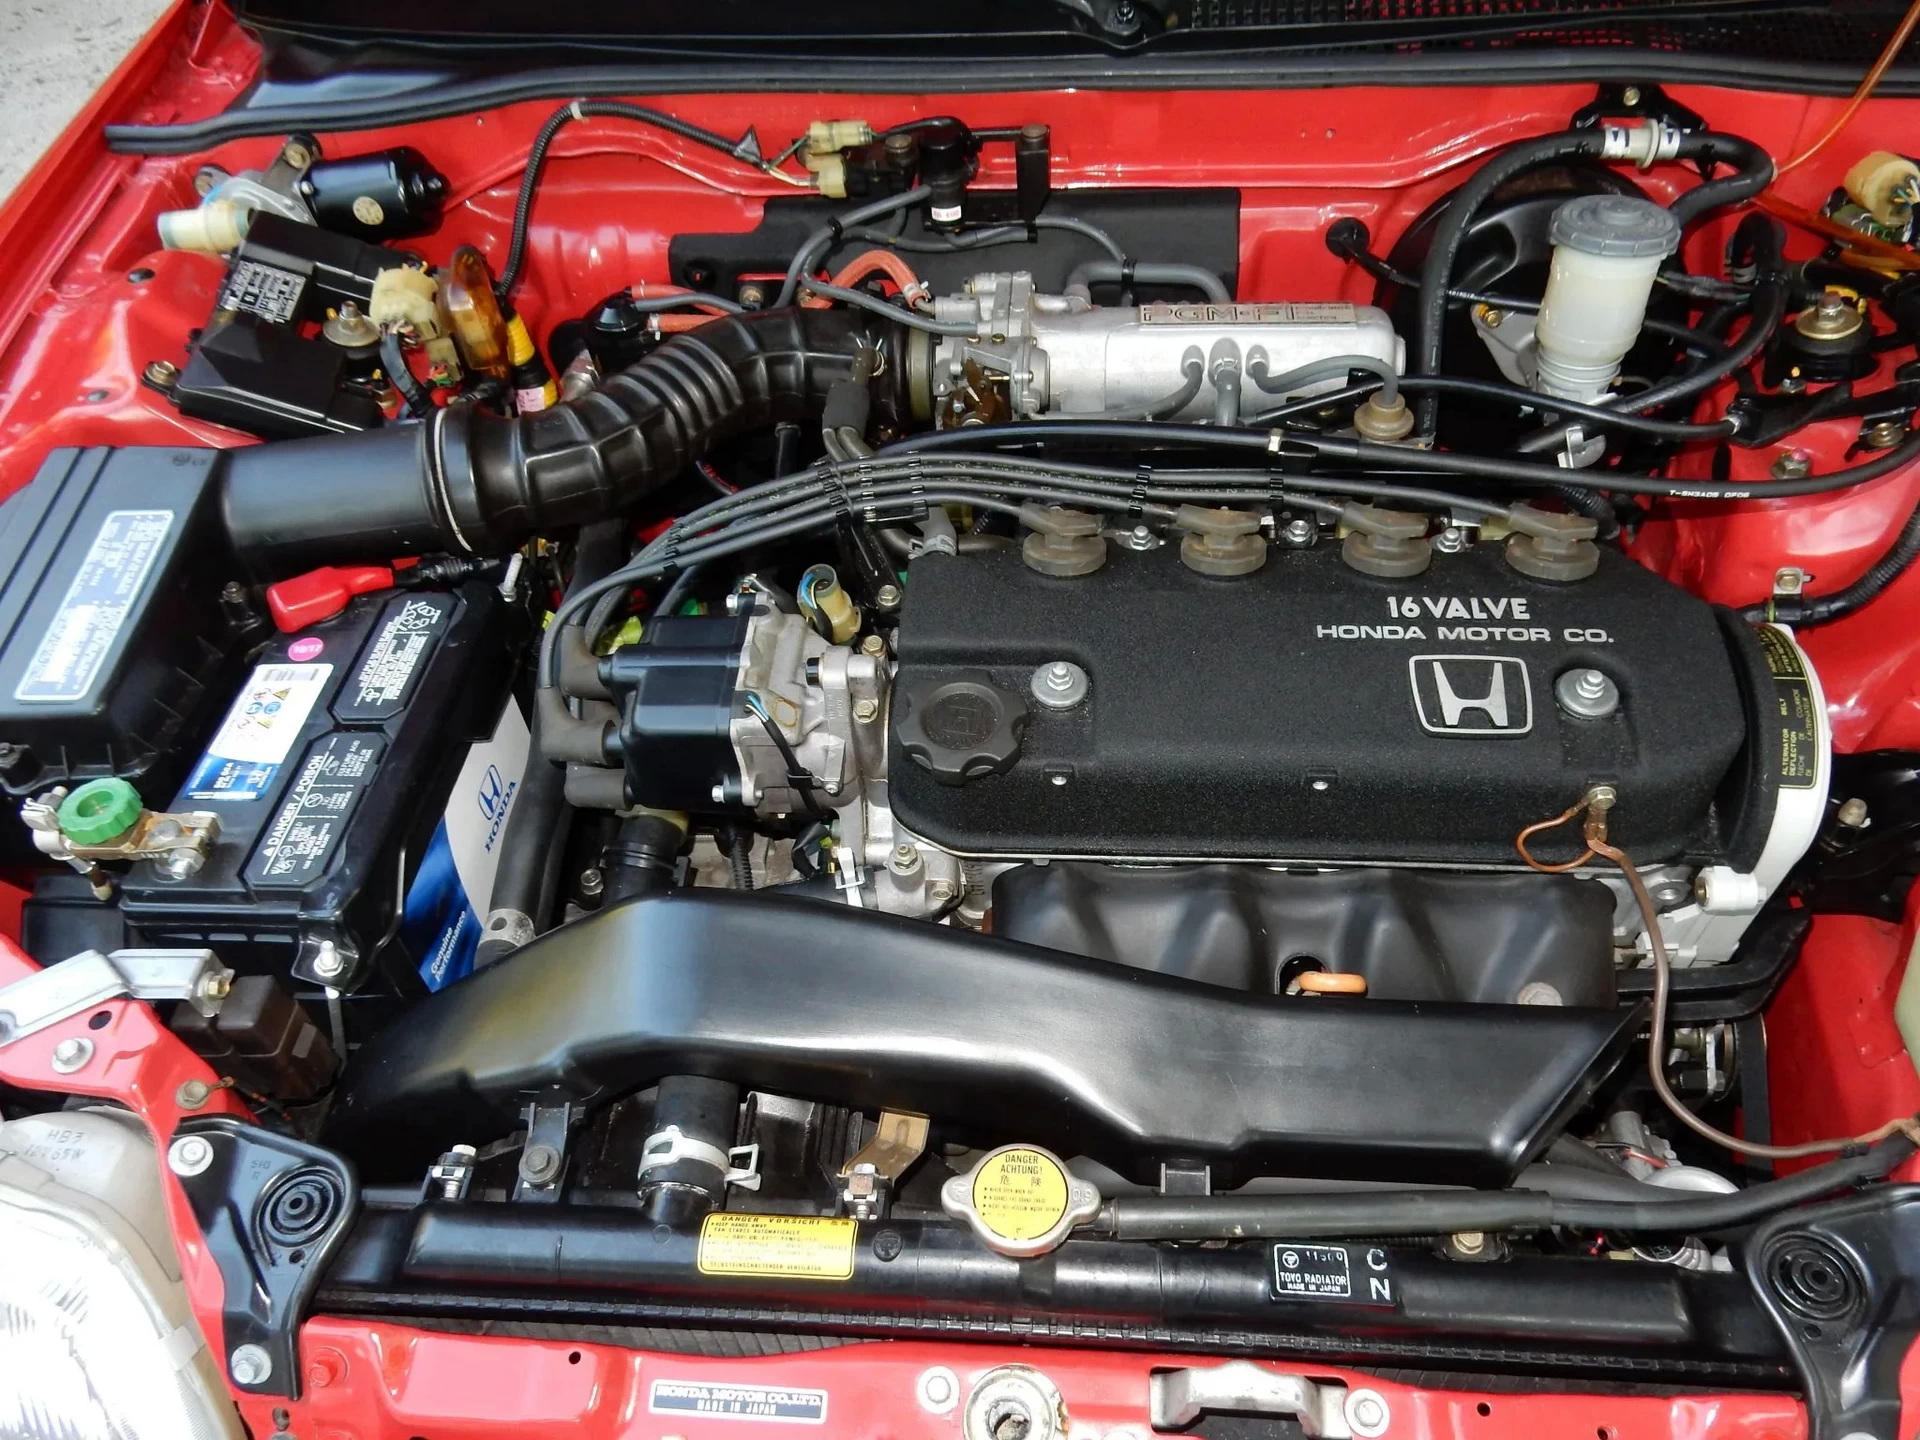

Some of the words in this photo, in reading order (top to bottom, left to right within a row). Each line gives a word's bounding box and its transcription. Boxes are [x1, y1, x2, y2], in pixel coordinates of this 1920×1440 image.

[1387, 596, 1420, 618] 16
[1422, 597, 1530, 620] VALVE
[1316, 625, 1426, 640] HONDA
[1438, 626, 1551, 641] MOTOR
[1564, 629, 1614, 643] CO.
[1779, 698, 1788, 716] BELT
[1789, 731, 1797, 776] DEFLECTION
[267, 802, 300, 849] DANGER
[295, 755, 324, 793] POISON
[485, 781, 516, 853] HONDA
[431, 927, 453, 974] Genuine
[435, 911, 466, 983] Performance
[1005, 1154, 1039, 1163] DANGER
[1000, 1165, 1043, 1175] ACHTUNG!
[769, 1217, 821, 1225] VORSICHT
[1367, 1248, 1387, 1271] C
[1280, 1272, 1301, 1283] TOYO
[1304, 1273, 1347, 1286] RADIATOR
[1370, 1277, 1391, 1300] N
[656, 1385, 710, 1399] HONDA
[712, 1388, 767, 1402] MOTOR
[697, 1399, 724, 1412] MADE
[730, 1401, 740, 1412] IN
[746, 1402, 777, 1416] JAPAN
